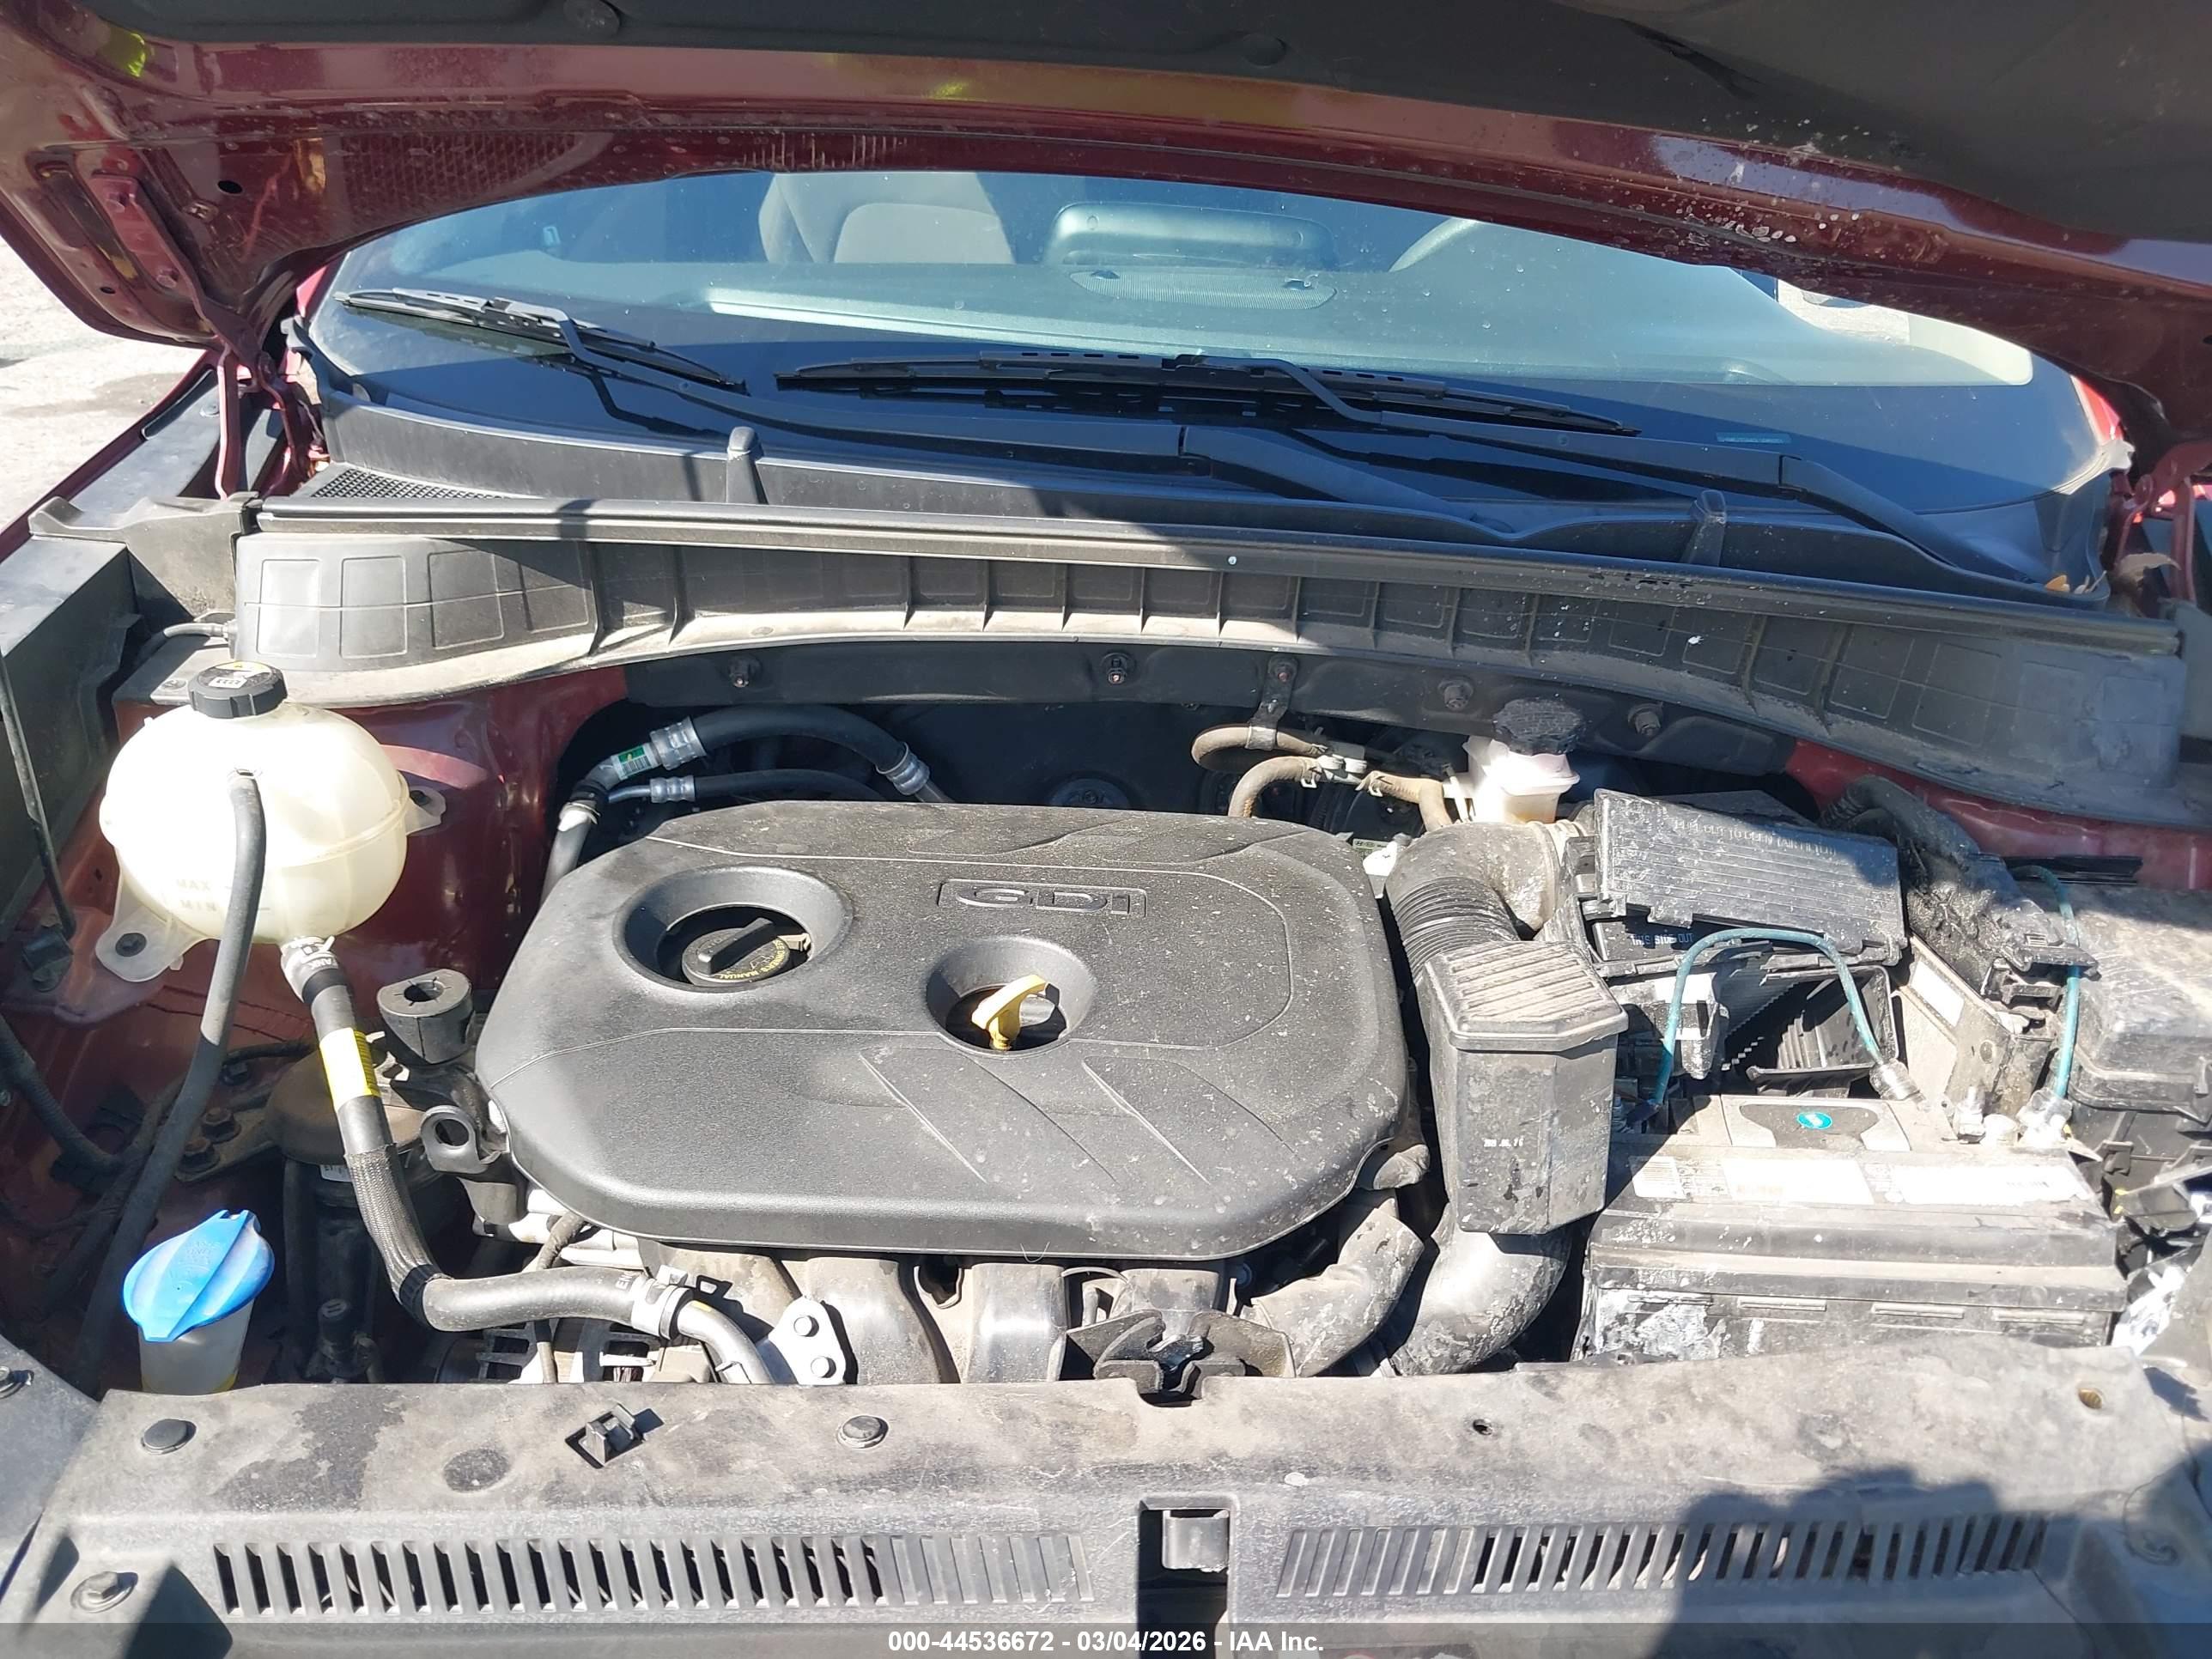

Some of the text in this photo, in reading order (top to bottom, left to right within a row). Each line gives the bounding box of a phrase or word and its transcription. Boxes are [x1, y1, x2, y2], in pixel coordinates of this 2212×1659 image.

[956, 887, 1131, 915] GDI
[1678, 933, 1694, 943] OUT
[720, 970, 760, 980] MANUAL
